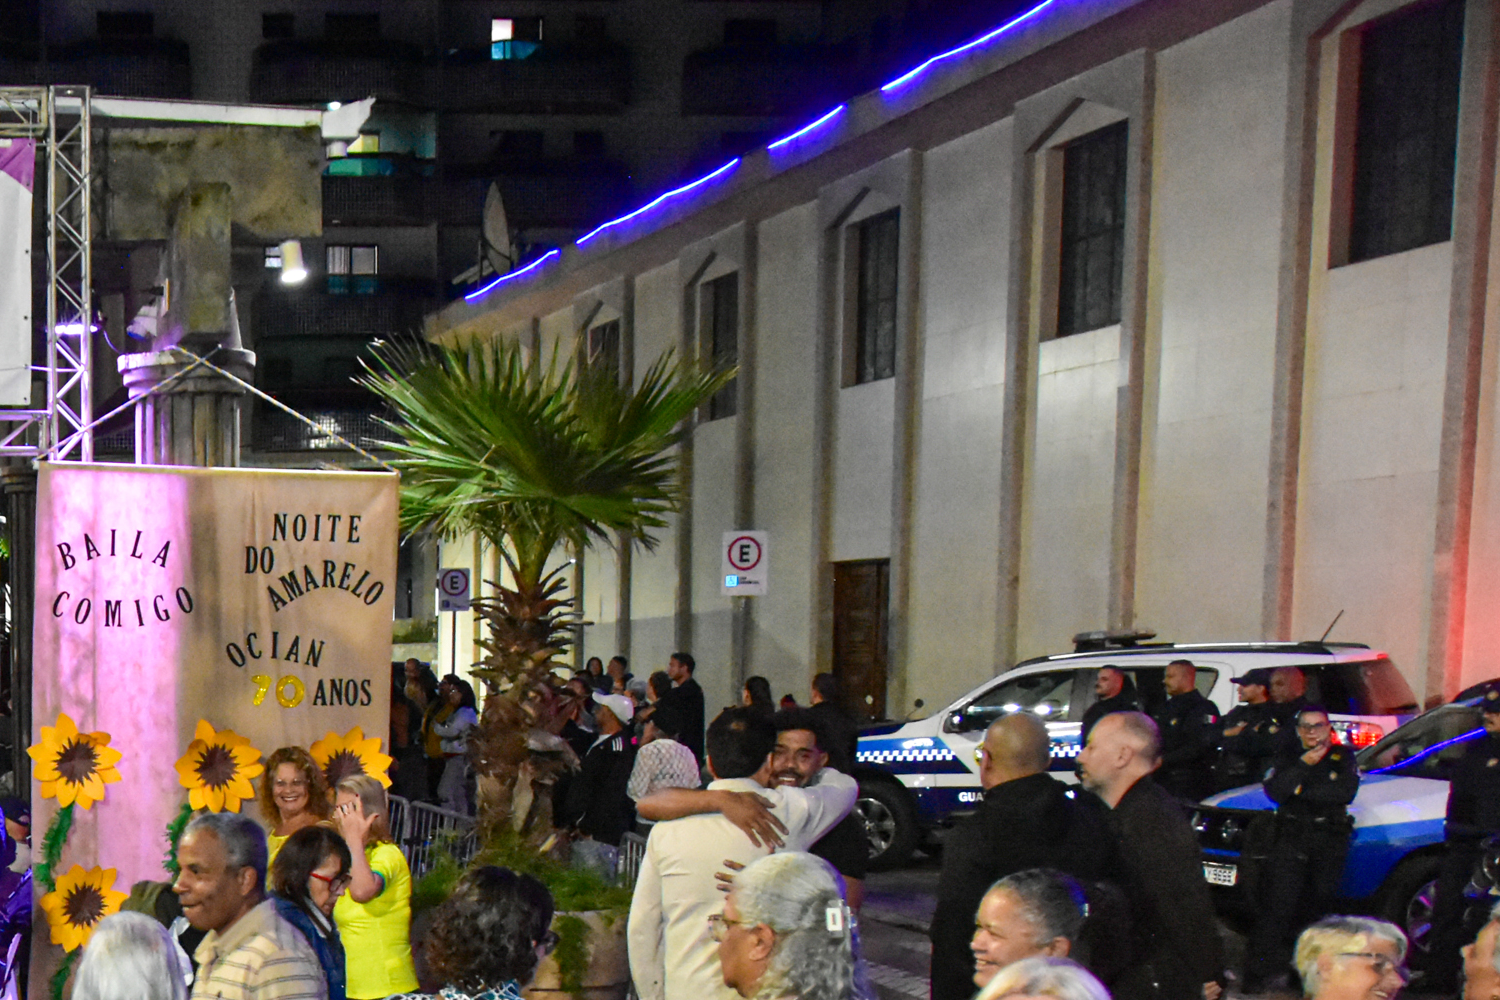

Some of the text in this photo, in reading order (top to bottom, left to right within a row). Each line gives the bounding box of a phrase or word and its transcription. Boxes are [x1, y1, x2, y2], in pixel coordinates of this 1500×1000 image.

[272, 513, 361, 543] NOITE
[57, 529, 171, 570] BAILA
[245, 546, 274, 574] DO
[739, 544, 750, 562] E
[267, 560, 384, 612] AMARELO
[450, 576, 460, 590] E
[53, 587, 193, 627] COMIGO
[226, 631, 325, 667] OCIAN
[252, 675, 372, 708] 70 ANOS
[958, 791, 986, 803] GUA
